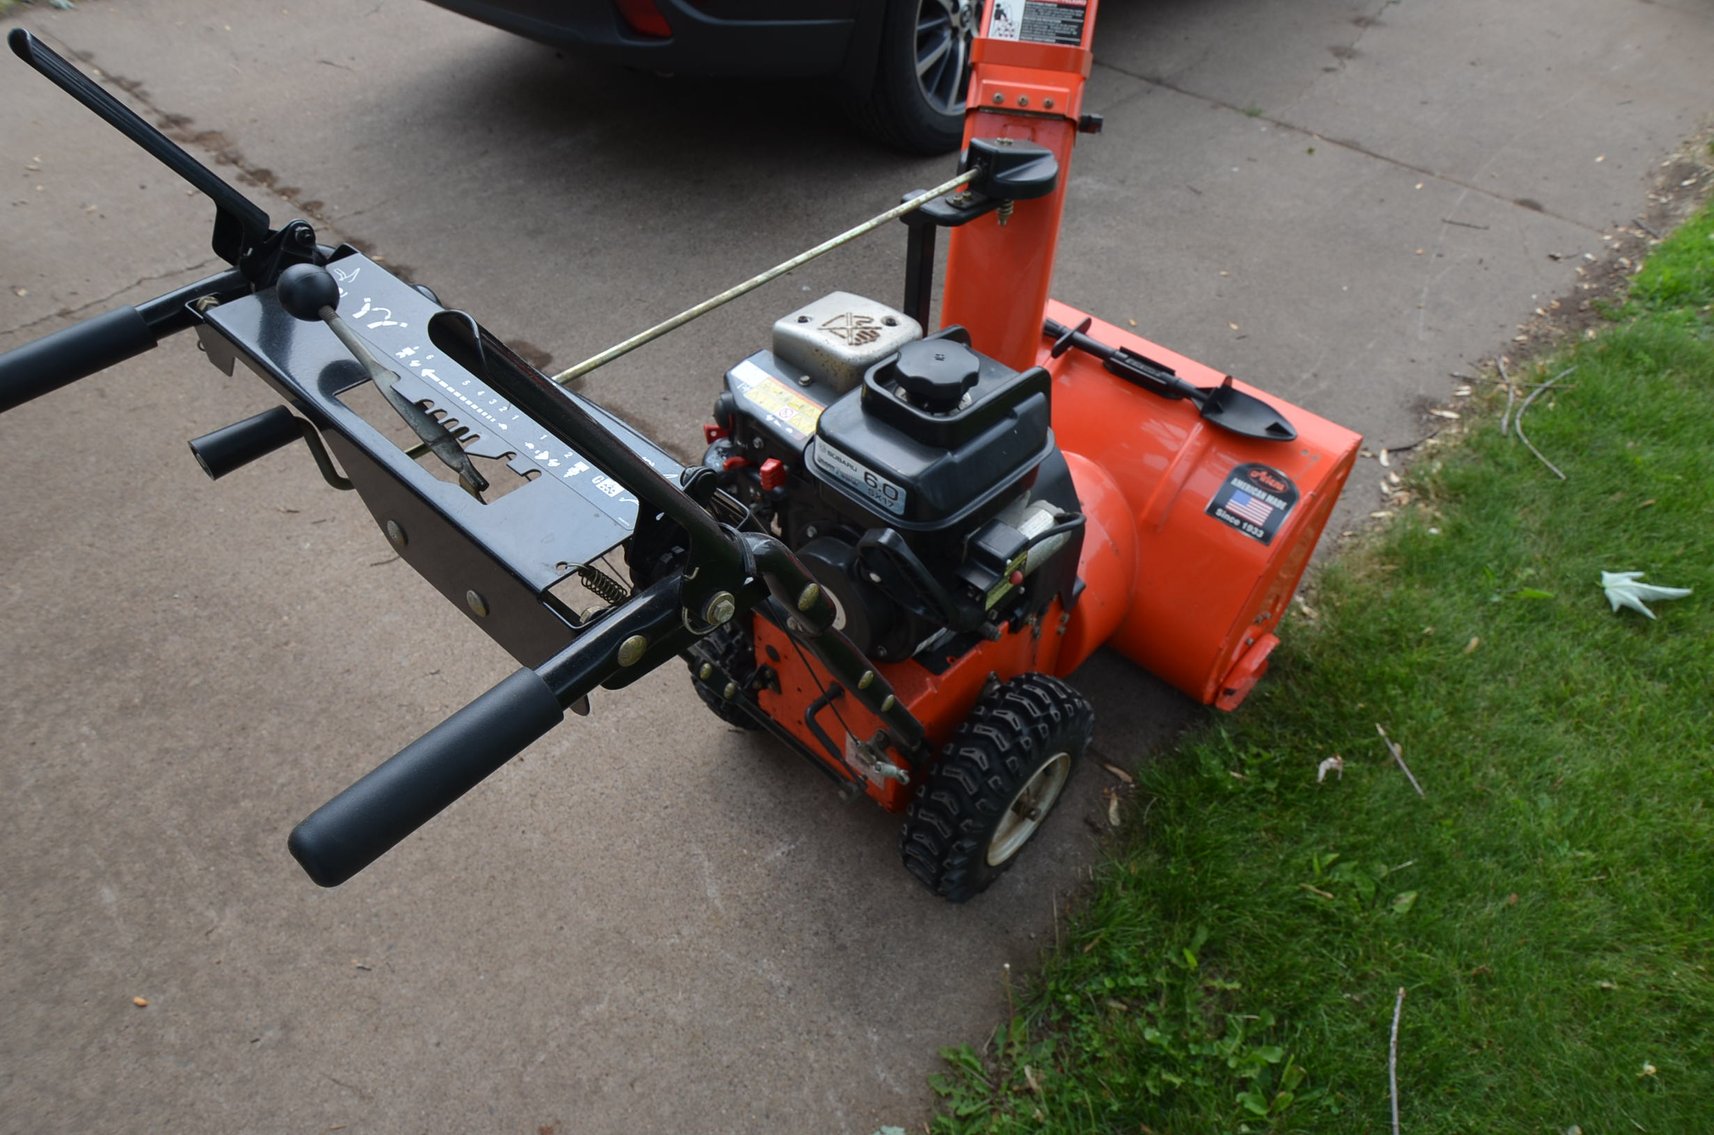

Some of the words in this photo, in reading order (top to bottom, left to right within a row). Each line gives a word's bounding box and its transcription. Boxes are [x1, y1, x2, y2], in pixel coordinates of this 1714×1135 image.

[827, 450, 858, 472] SUBARU
[864, 471, 899, 501] 6.0
[1230, 477, 1268, 501] AMERICAN
[1265, 493, 1288, 511] MADE
[1215, 508, 1241, 527] Since
[1242, 522, 1265, 538] 1933
